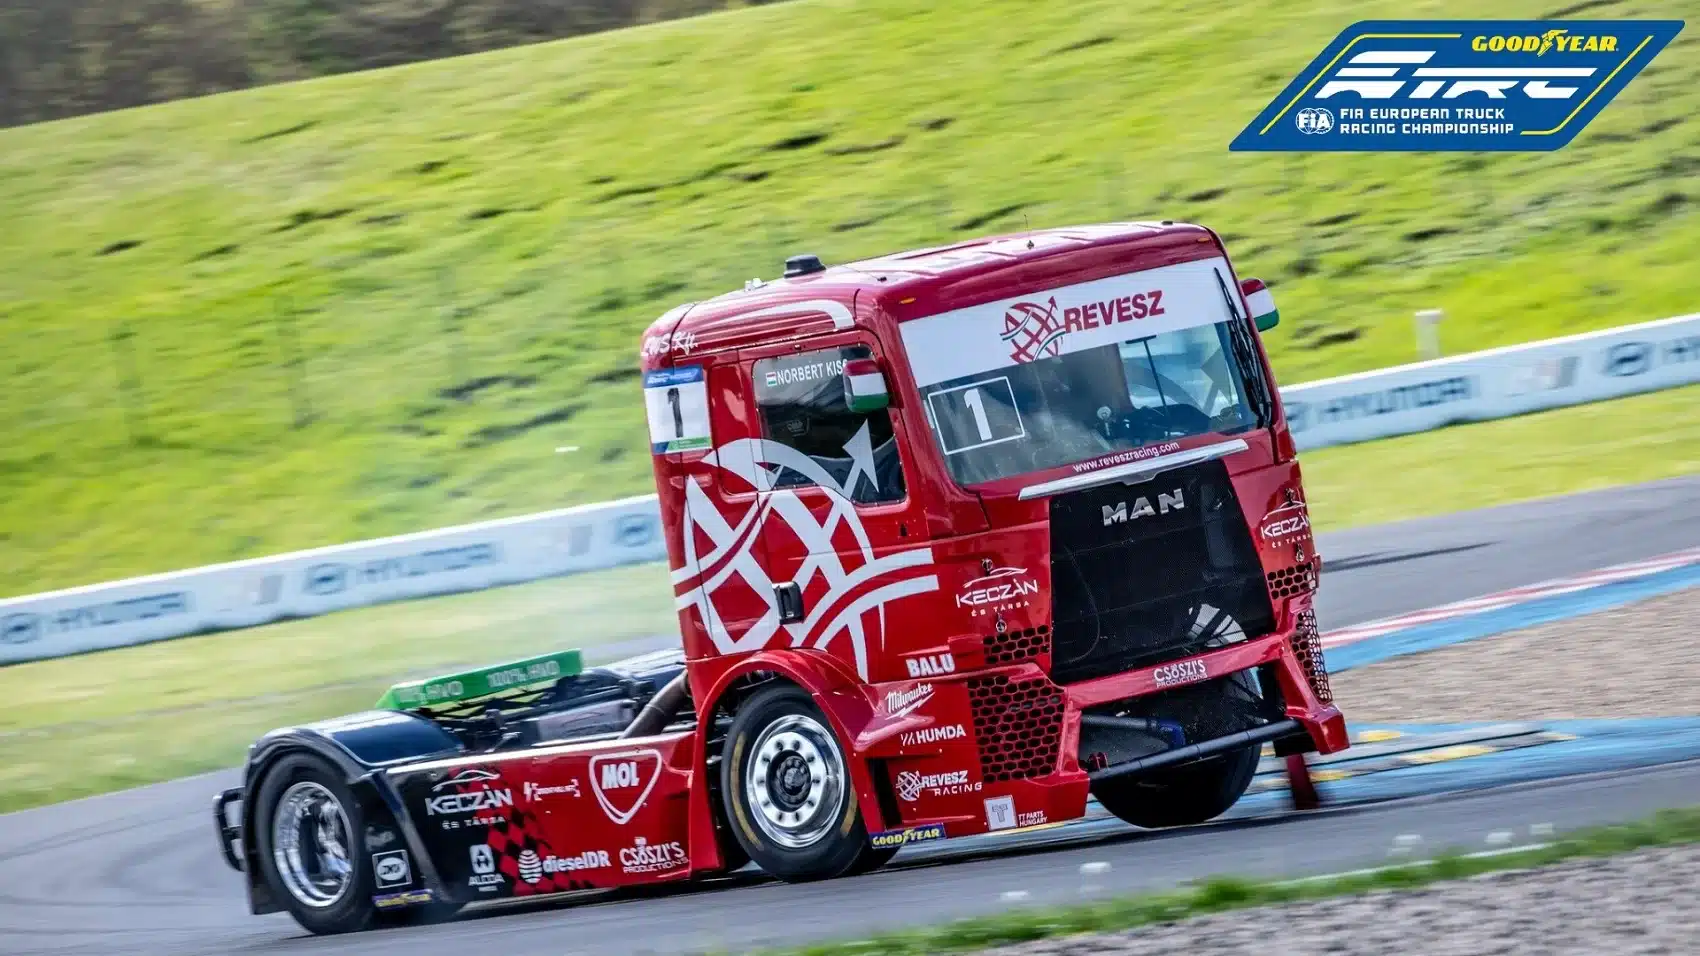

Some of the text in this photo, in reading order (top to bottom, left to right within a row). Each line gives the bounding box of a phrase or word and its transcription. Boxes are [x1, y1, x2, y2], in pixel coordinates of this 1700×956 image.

[1064, 290, 1165, 333] REVESZ
[777, 363, 823, 385] NORBERT
[667, 387, 683, 438] 1
[963, 387, 993, 441] 1
[1072, 440, 1180, 473] www.reveszracing.com
[1102, 488, 1185, 526] MAN
[906, 653, 955, 677] BALU
[884, 682, 933, 713] Milwaukee
[916, 724, 966, 744] HUMDA
[601, 762, 639, 789] MOL
[921, 770, 968, 788] REVESZ
[934, 782, 983, 797] RACING
[872, 828, 940, 846] GOODYEAR
[542, 850, 611, 873] dieselDR
